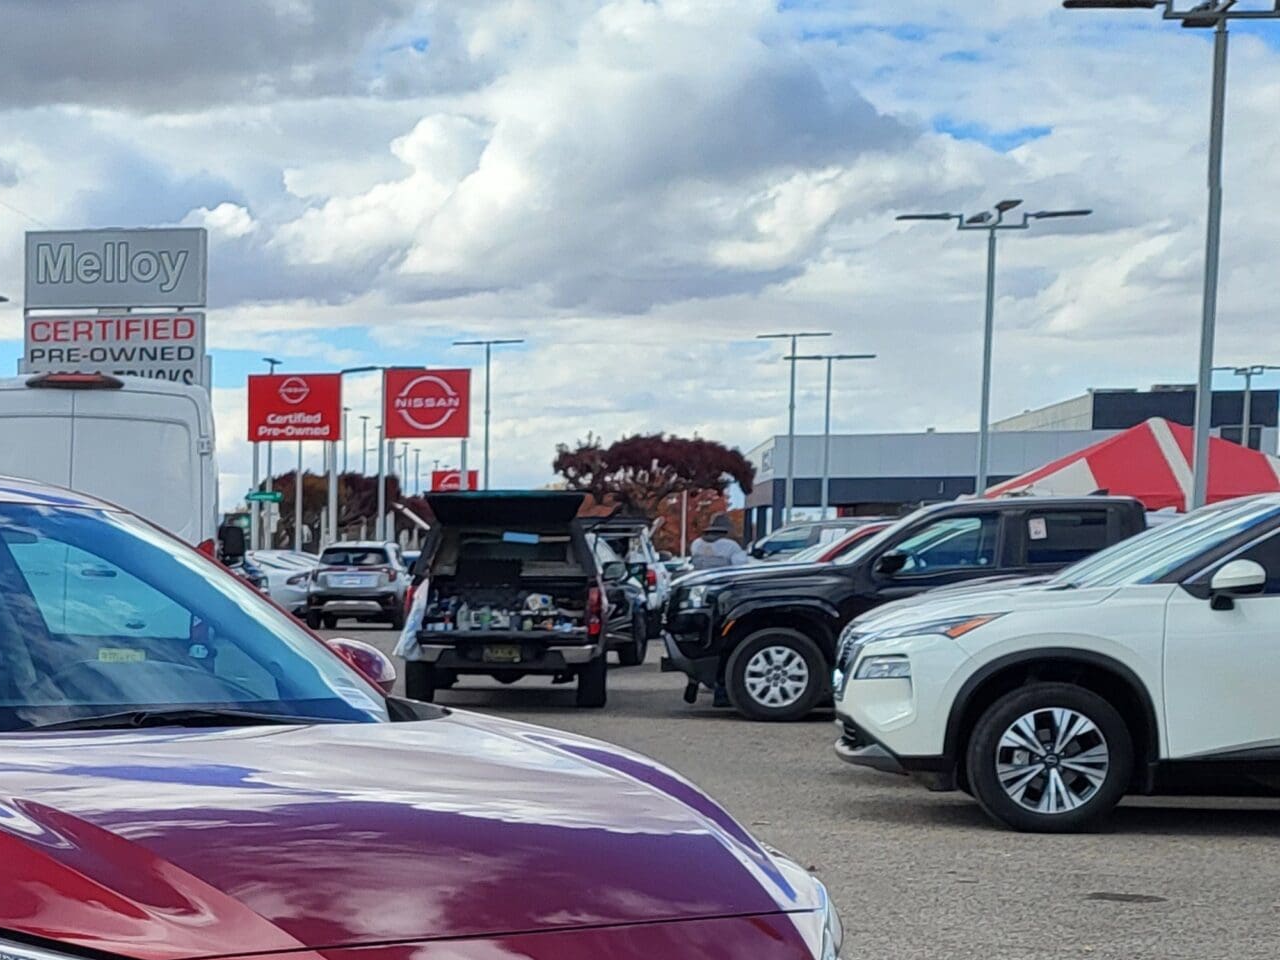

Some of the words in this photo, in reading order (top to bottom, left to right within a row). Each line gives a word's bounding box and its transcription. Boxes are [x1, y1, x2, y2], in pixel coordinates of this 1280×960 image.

[37, 242, 189, 292] Melloy
[30, 318, 196, 342] CERTIFIED
[30, 346, 195, 363] PRE-OWNED
[395, 397, 460, 408] NISSAN
[266, 412, 322, 424] Certified
[257, 424, 330, 436] Pre-Owned
